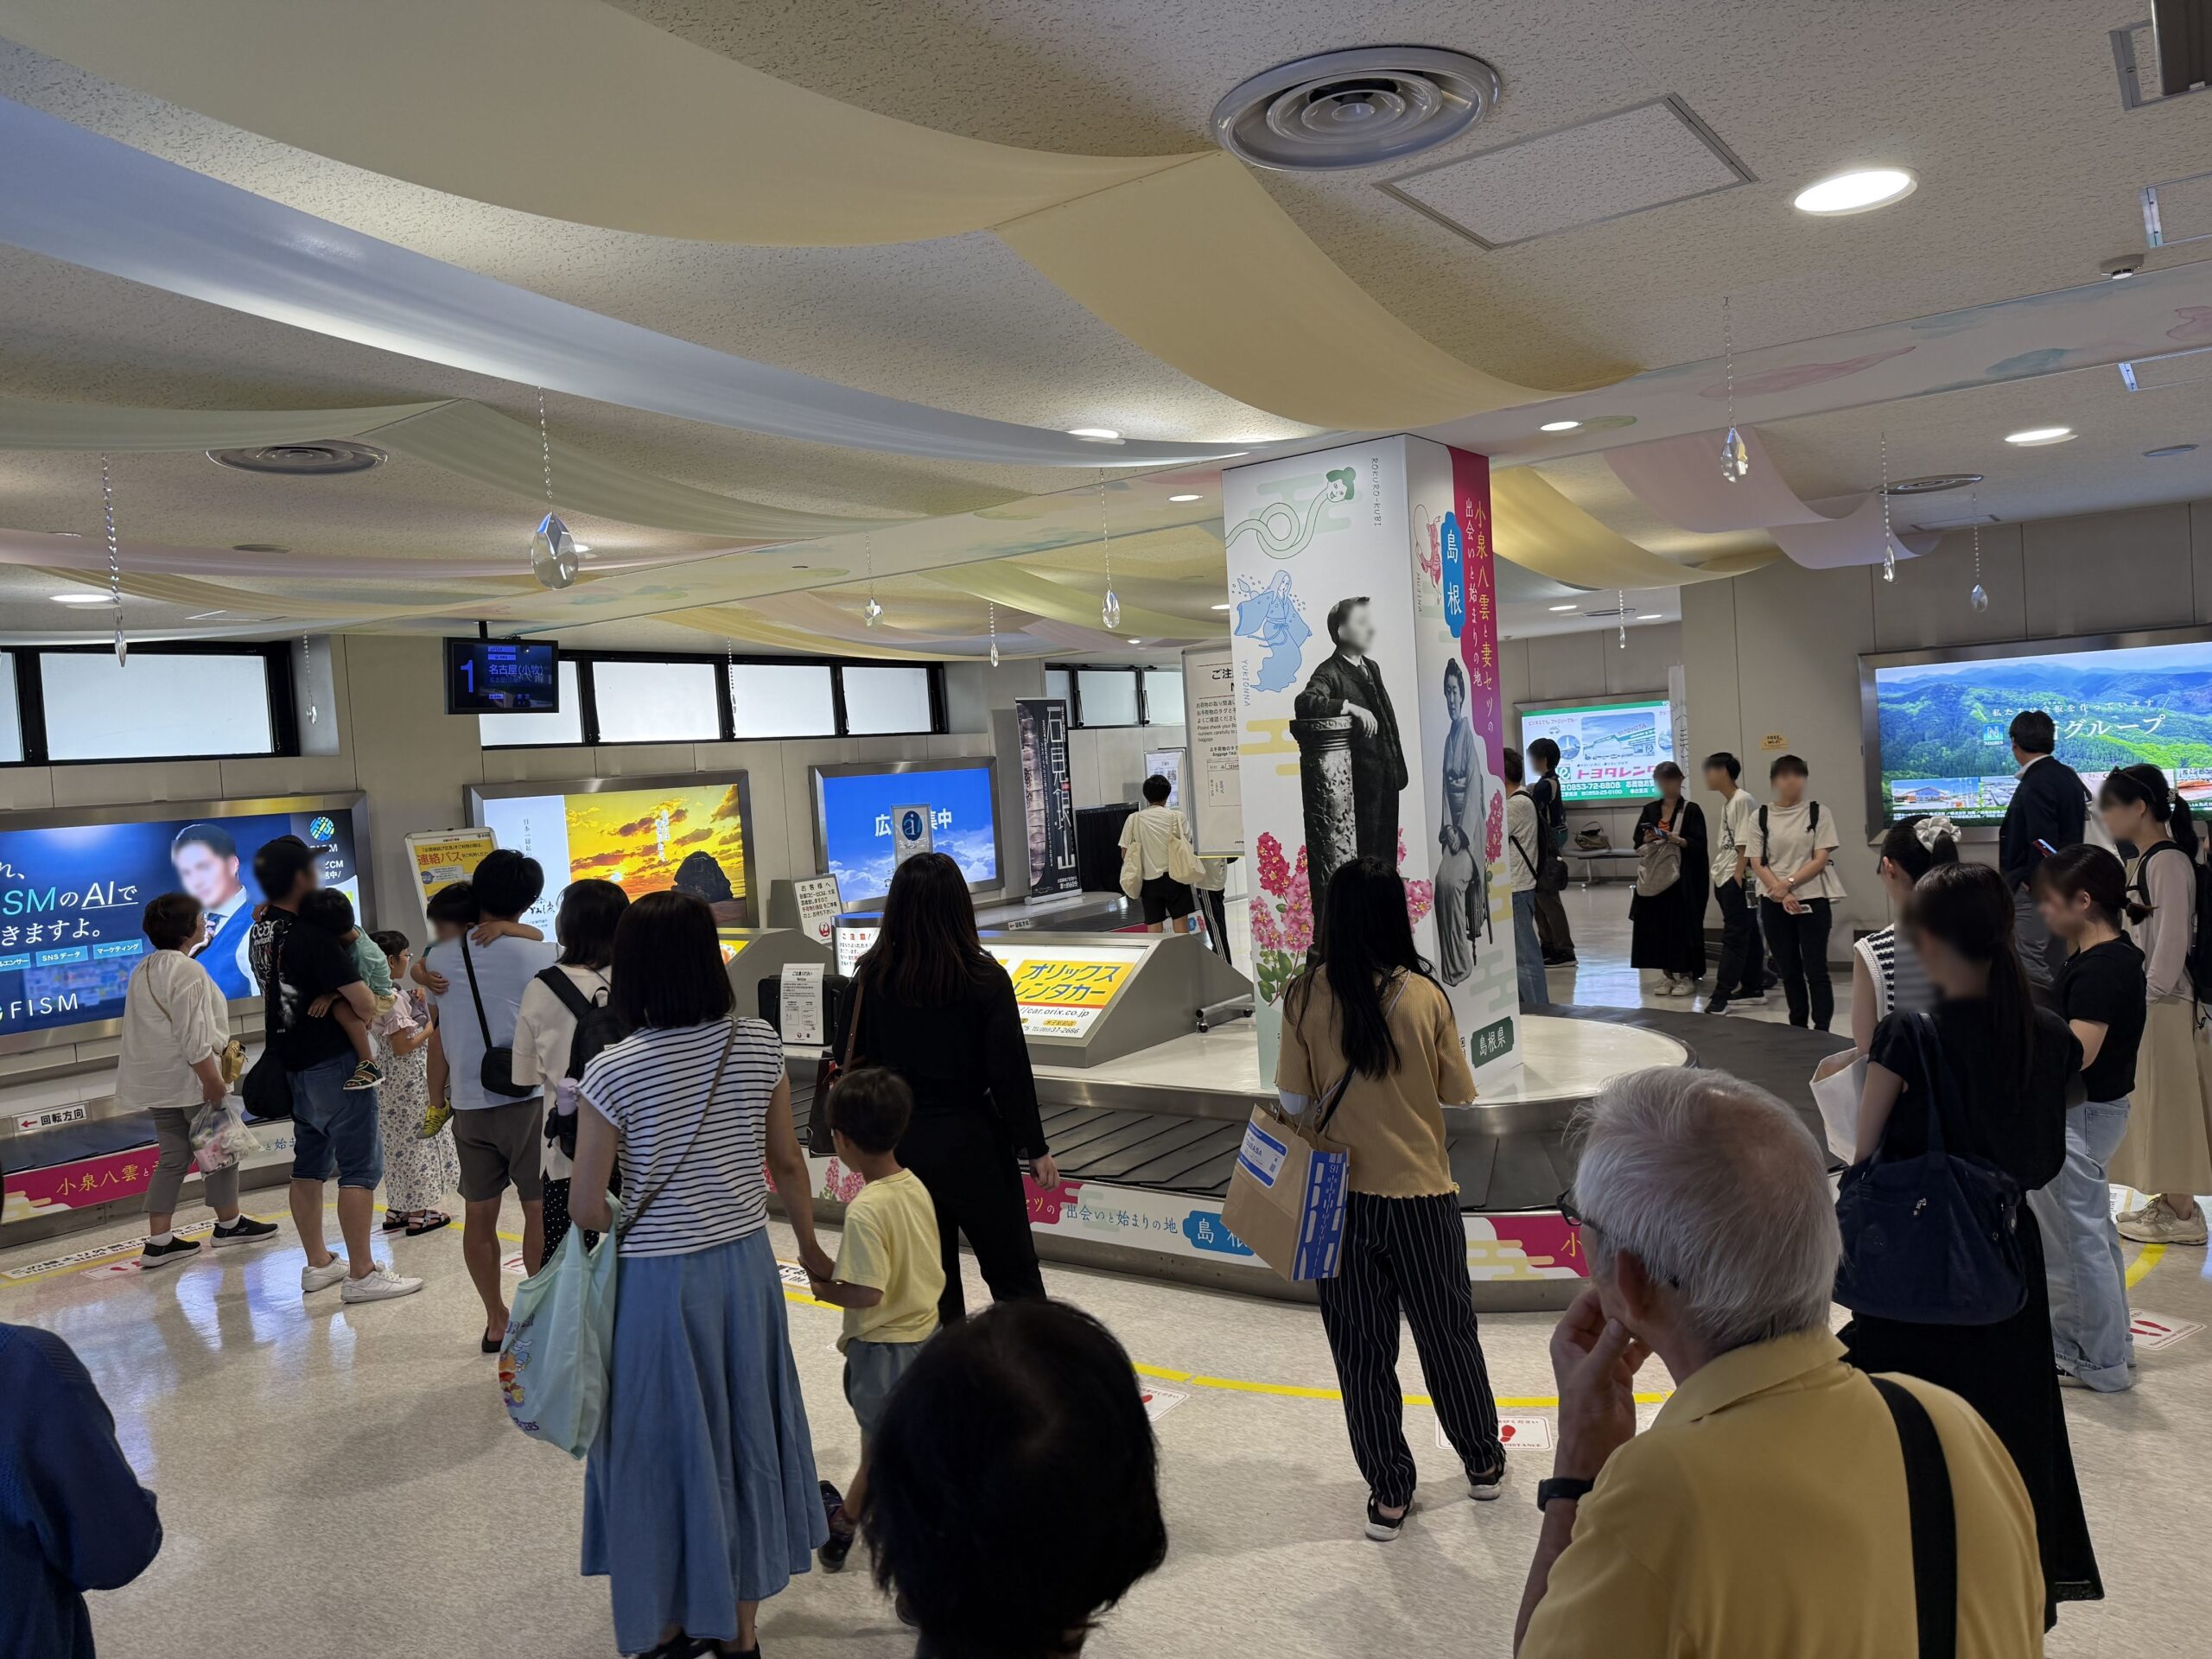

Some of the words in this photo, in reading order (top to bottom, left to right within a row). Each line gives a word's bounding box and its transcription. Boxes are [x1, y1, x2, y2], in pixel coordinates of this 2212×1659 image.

[1371, 457, 1382, 526] ROKURO-KUBI
[1446, 529, 1463, 615] 島根
[1465, 497, 1483, 687] 出会いと始まりの地
[1474, 500, 1494, 733] 小泉八雲と妻セツの
[461, 659, 474, 693] 1
[1242, 659, 1251, 707] YUKIONNA
[97, 943, 140, 955] マーケティング
[1020, 963, 1122, 982] オリックス
[10, 993, 79, 1020] FISM
[1014, 982, 1106, 1001] レンタカー
[1479, 1026, 1506, 1056] 島根県
[41, 1109, 84, 1126] 回転方向
[1066, 1204, 1179, 1235] 出会いと始まりの地
